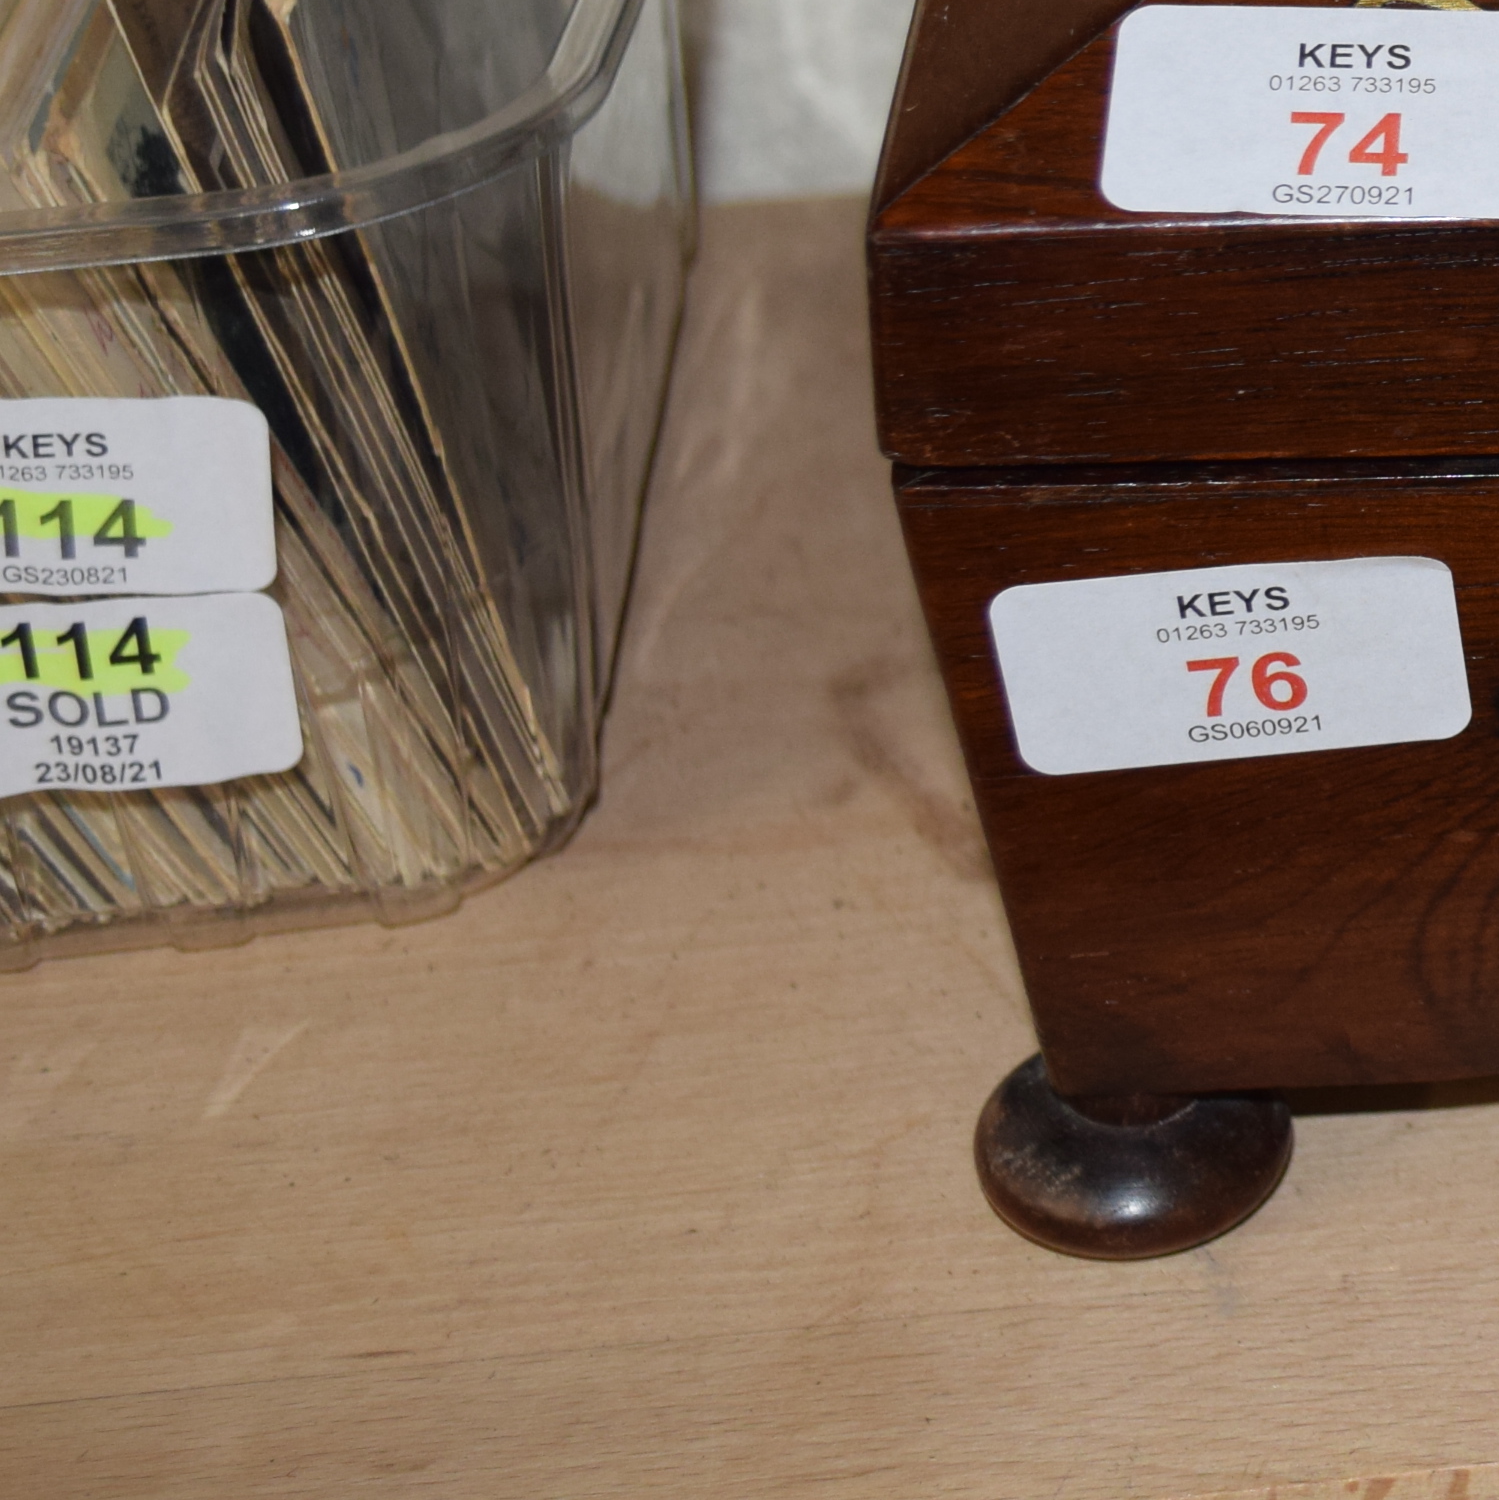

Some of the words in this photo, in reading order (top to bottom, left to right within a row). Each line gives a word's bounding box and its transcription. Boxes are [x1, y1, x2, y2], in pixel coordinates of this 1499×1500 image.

[1298, 42, 1412, 70] KEYS
[1268, 74, 1342, 93] 01263
[1350, 75, 1437, 95] 733195
[1290, 111, 1409, 177] 74
[1272, 183, 1415, 206] GS270921
[3, 432, 109, 459] KEYS
[55, 463, 134, 481] 733195
[0, 498, 147, 560] 114
[2, 565, 128, 586] GS230821
[1177, 585, 1291, 620] KEYS
[1156, 622, 1229, 644] 01263
[1234, 613, 1321, 637] 733195
[1, 615, 162, 681] 114
[1186, 650, 1309, 718] 76
[8, 687, 170, 729] SOLD
[1187, 714, 1323, 744] GS060921
[49, 733, 139, 757] 19137
[34, 760, 163, 785] 23/08/21
